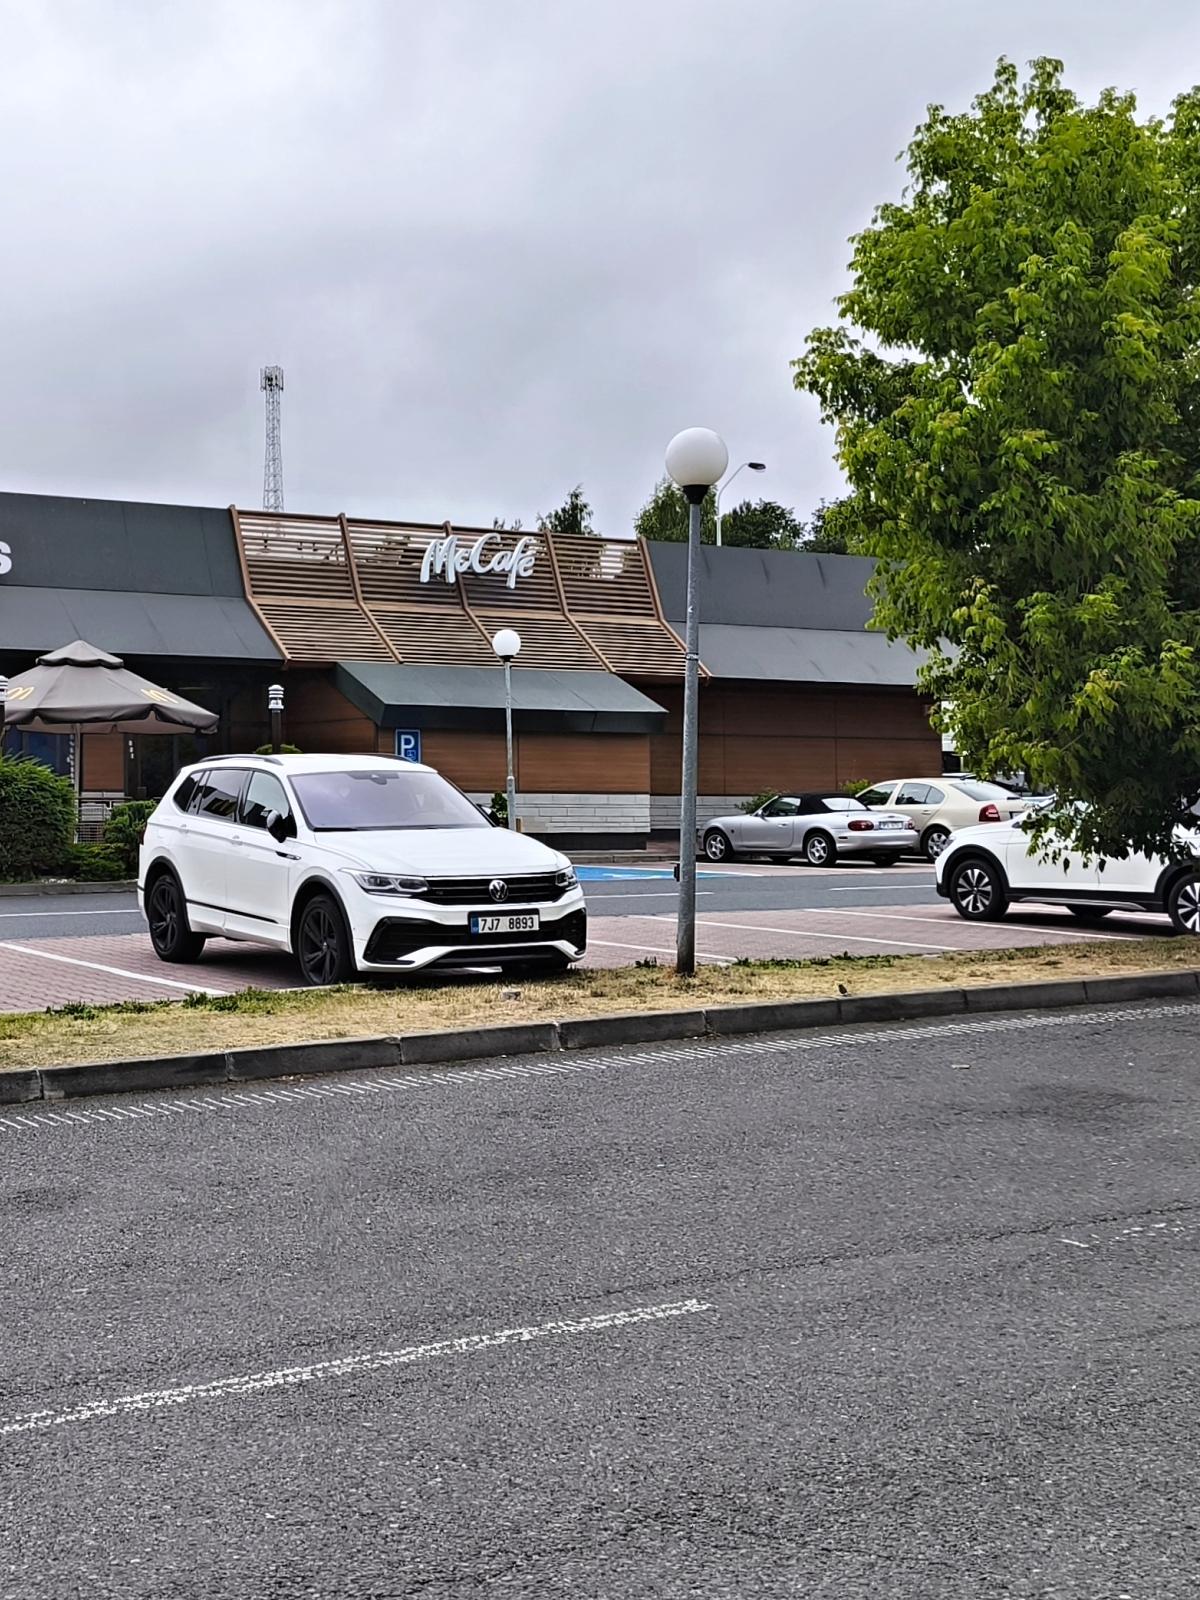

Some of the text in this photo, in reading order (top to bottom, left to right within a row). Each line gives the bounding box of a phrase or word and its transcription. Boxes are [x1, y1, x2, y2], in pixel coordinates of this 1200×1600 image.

[420, 533, 536, 589] McCafé
[401, 734, 415, 757] P
[481, 918, 500, 931] 7J7
